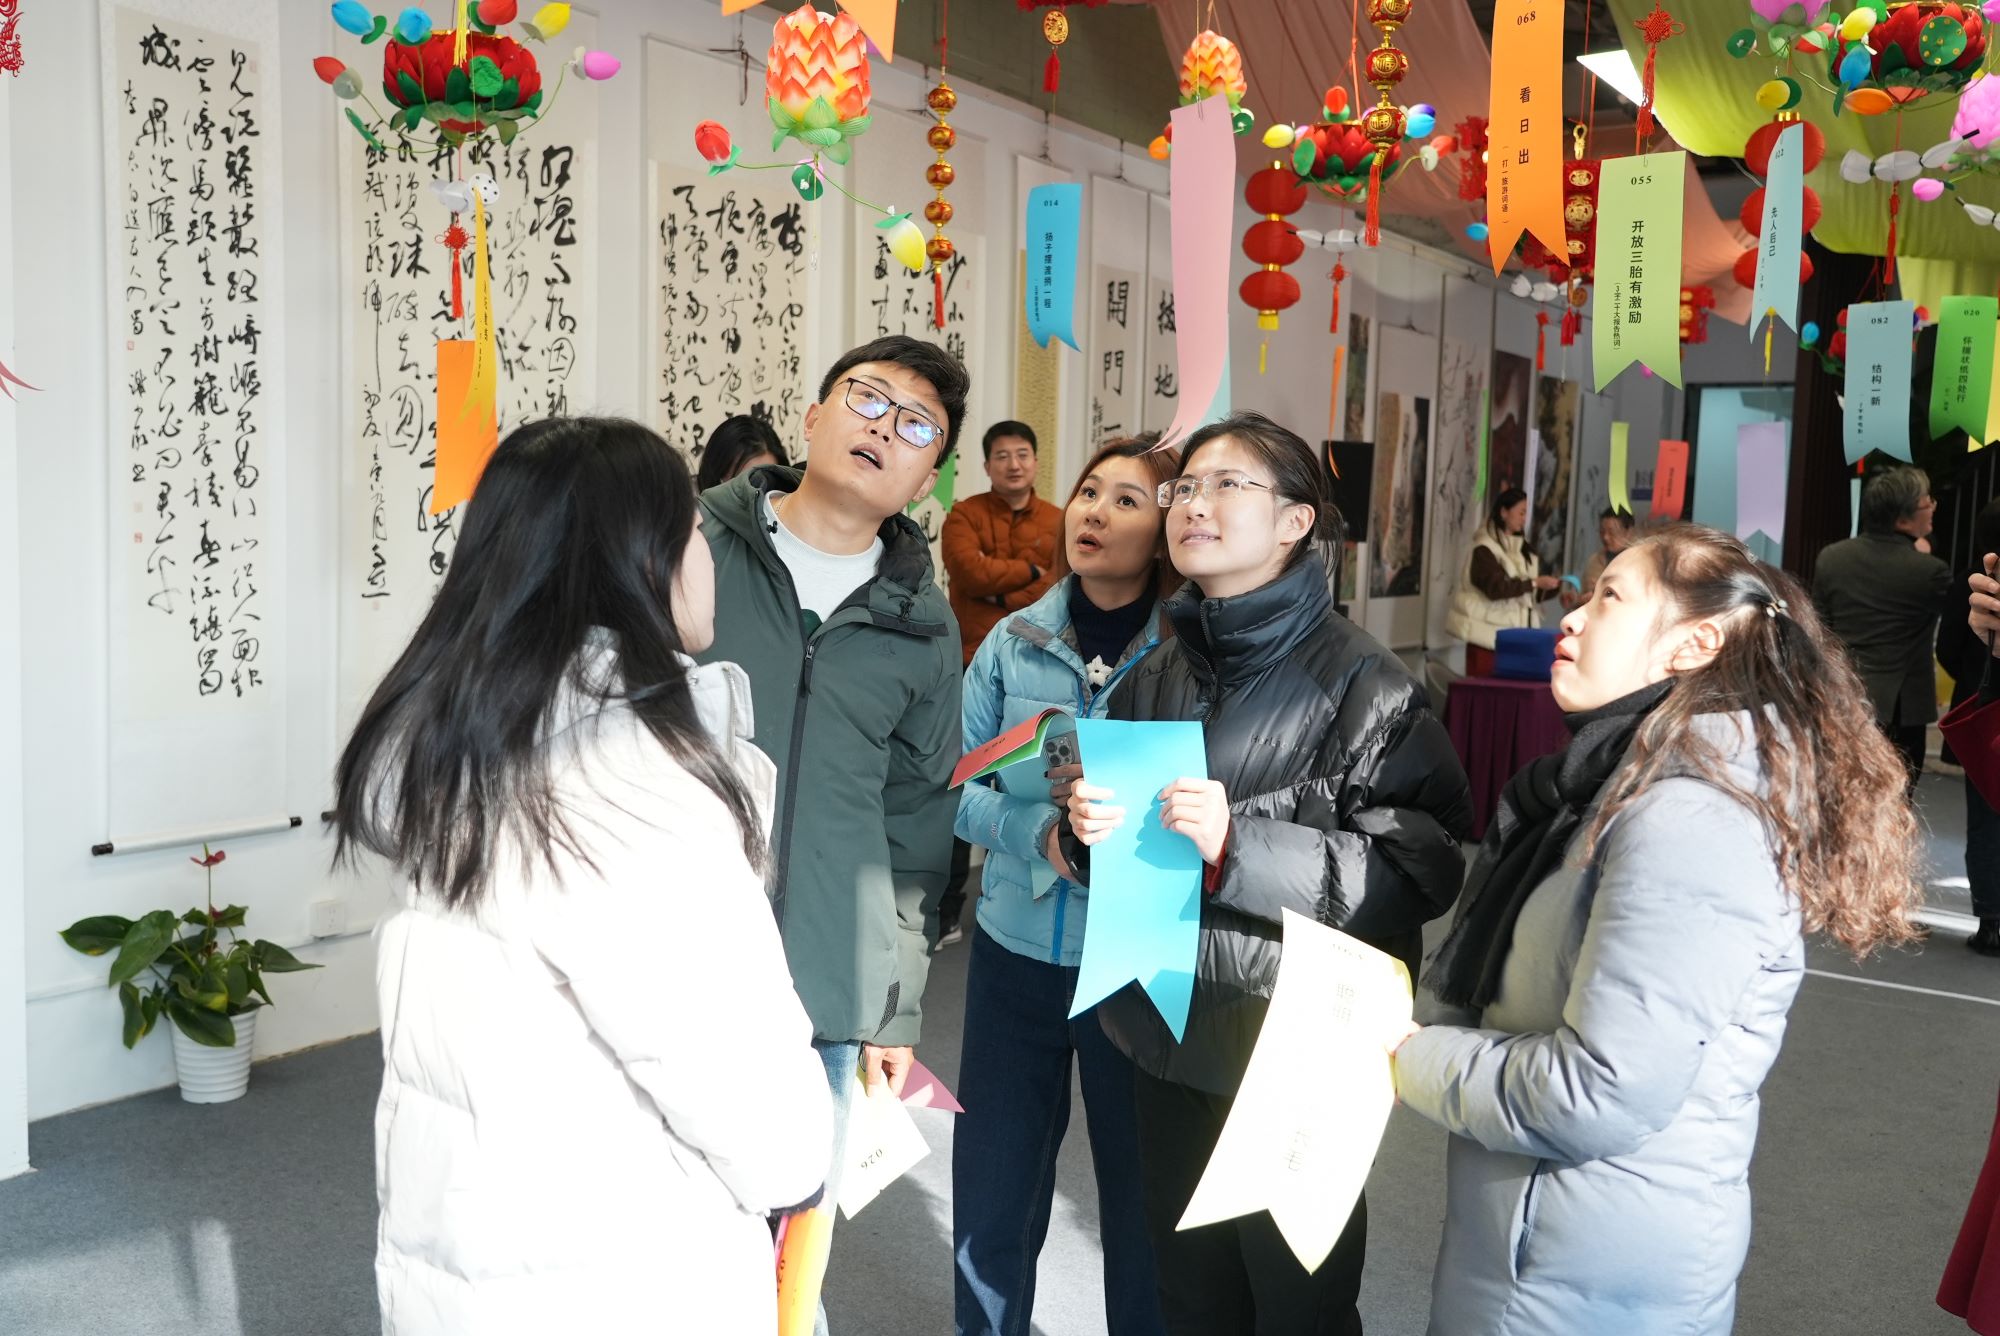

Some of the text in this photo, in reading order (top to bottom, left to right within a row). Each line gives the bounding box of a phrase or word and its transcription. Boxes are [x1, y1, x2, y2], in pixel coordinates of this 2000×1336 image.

[1517, 11, 1536, 26] 068
[1518, 86, 1532, 165] 看日出
[1631, 175, 1653, 186] 055
[1628, 220, 1645, 325] 开放三胎有激励
[1871, 317, 1889, 325] 082
[1871, 363, 1882, 407] 结构一新
[860, 1148, 883, 1171] 026
